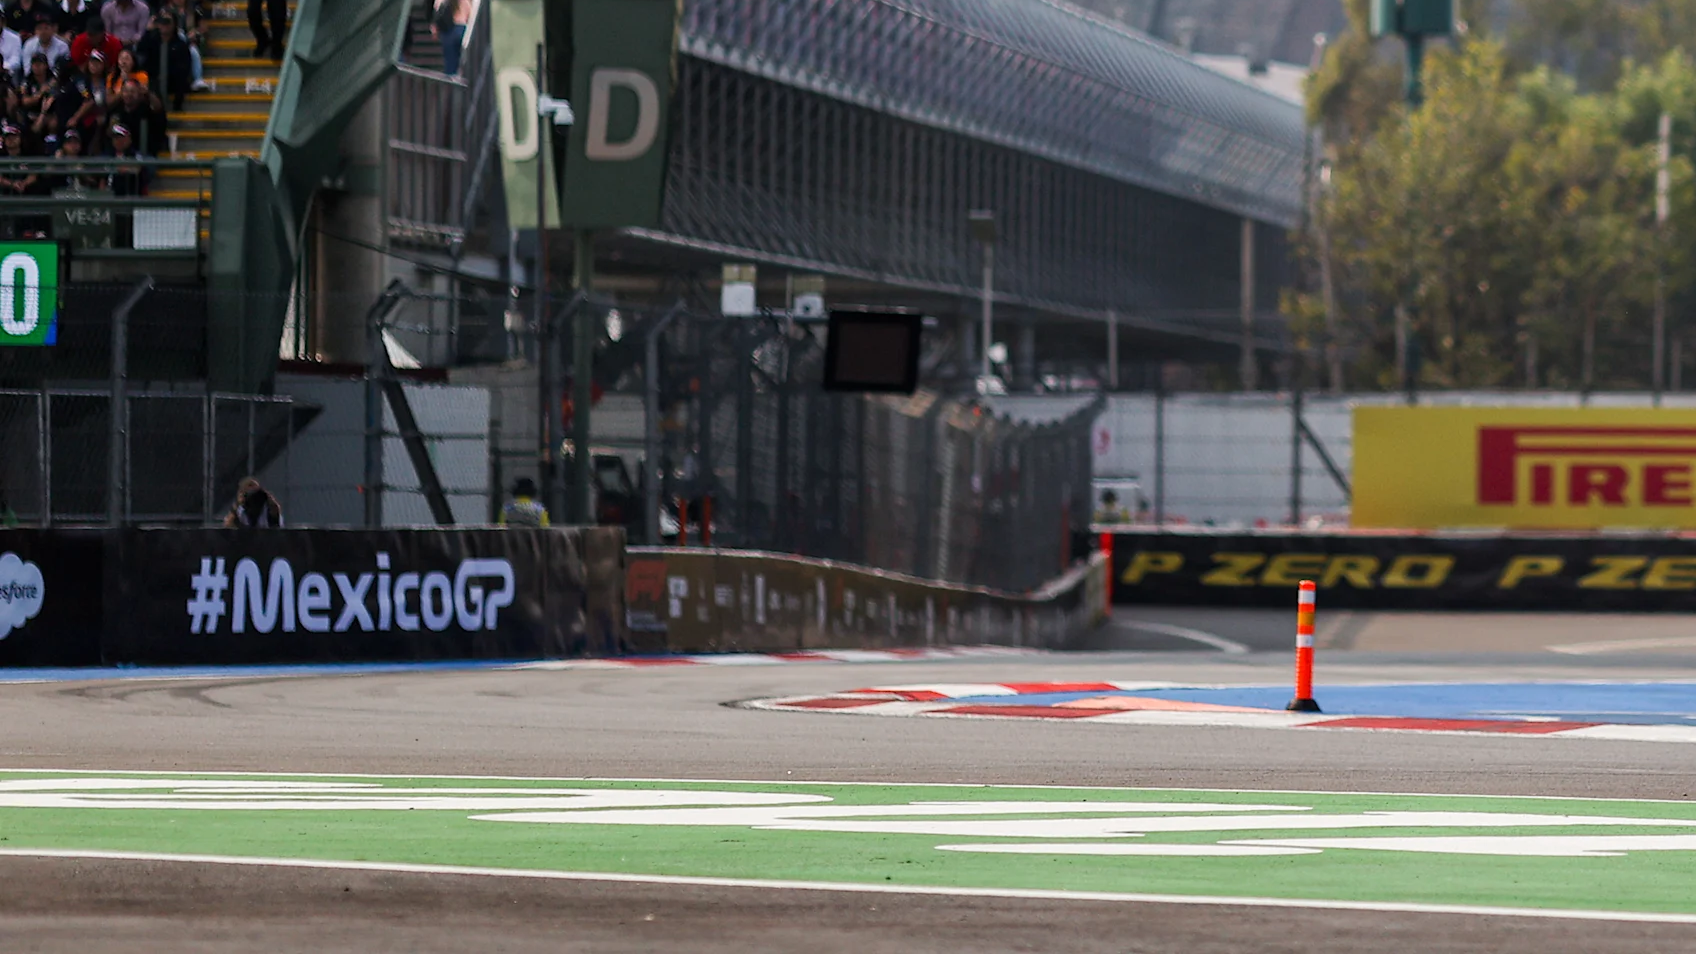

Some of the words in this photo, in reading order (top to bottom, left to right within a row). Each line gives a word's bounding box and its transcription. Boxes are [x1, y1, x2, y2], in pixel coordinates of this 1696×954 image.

[498, 67, 539, 161] D
[586, 67, 660, 162] D
[186, 551, 515, 633] #MexicoGP
[1121, 552, 1184, 584] P
[1200, 553, 1454, 588] ZERO
[1500, 556, 1563, 589] P
